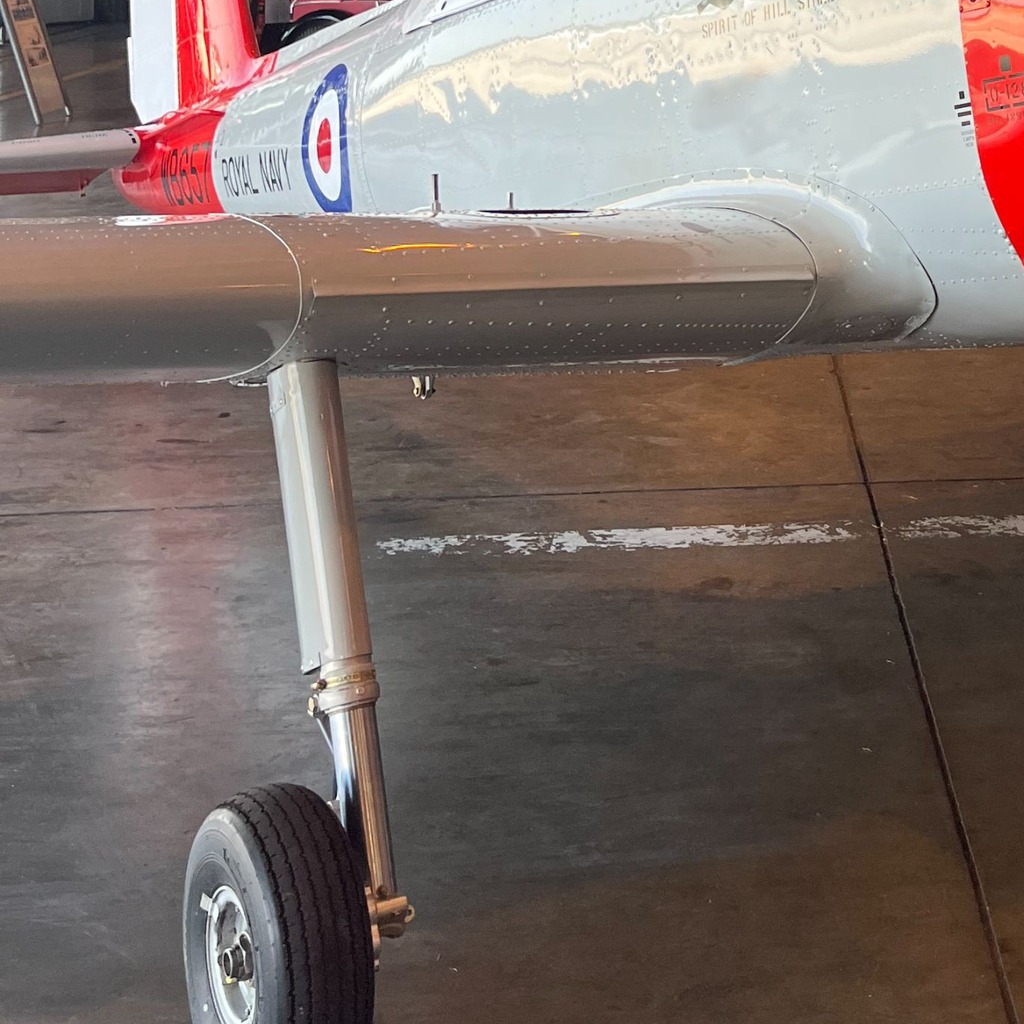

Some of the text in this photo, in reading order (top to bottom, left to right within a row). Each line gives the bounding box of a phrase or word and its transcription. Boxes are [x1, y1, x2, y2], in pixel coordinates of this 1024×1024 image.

[701, 14, 738, 39] SPIRIT
[744, 8, 757, 27] OF
[763, 0, 791, 21] HILL
[161, 142, 211, 207] WB657
[221, 147, 292, 197] ROYAL NAVY
